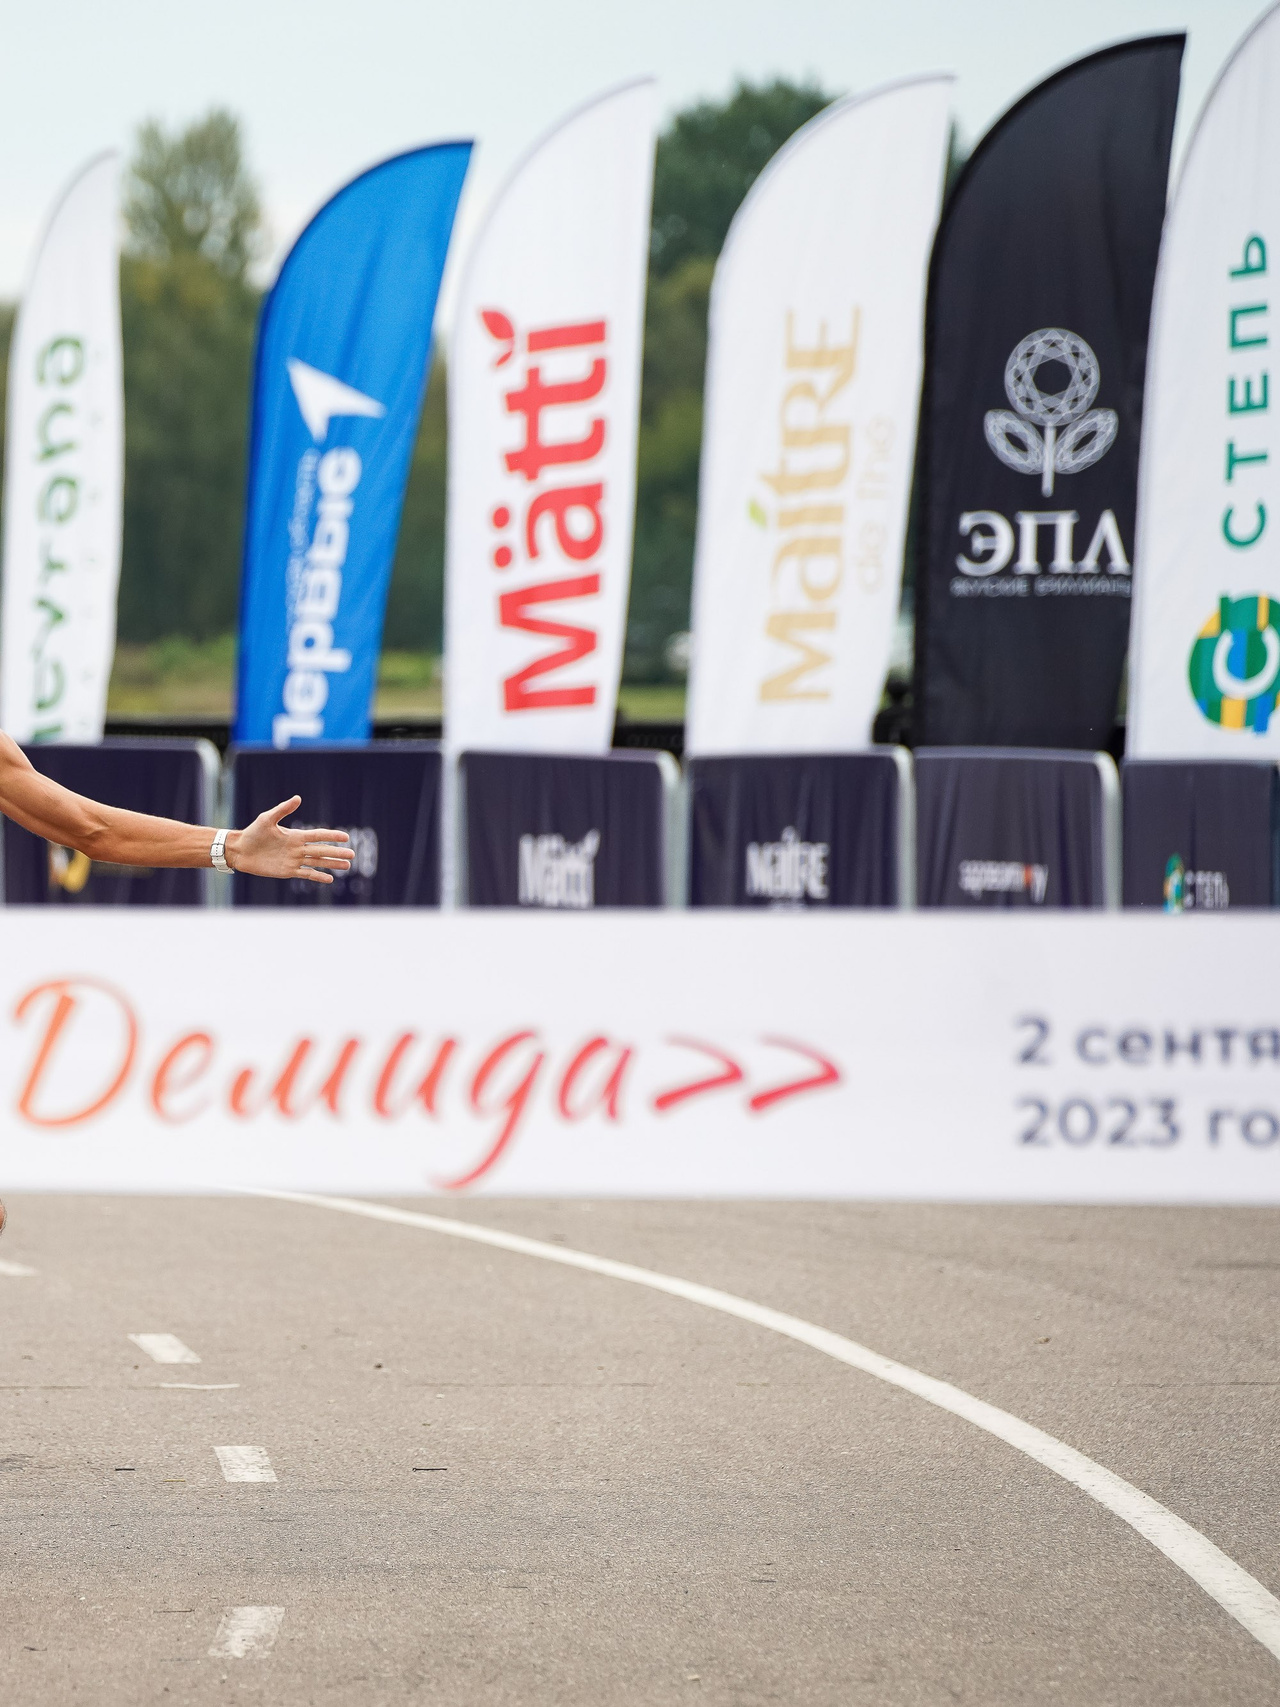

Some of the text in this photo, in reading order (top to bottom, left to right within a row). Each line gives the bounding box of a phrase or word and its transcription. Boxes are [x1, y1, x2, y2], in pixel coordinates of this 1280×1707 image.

[1221, 231, 1269, 550] СТЕПЬ
[1016, 1015, 1050, 1066] 2
[1016, 1096, 1180, 1148] 2023
